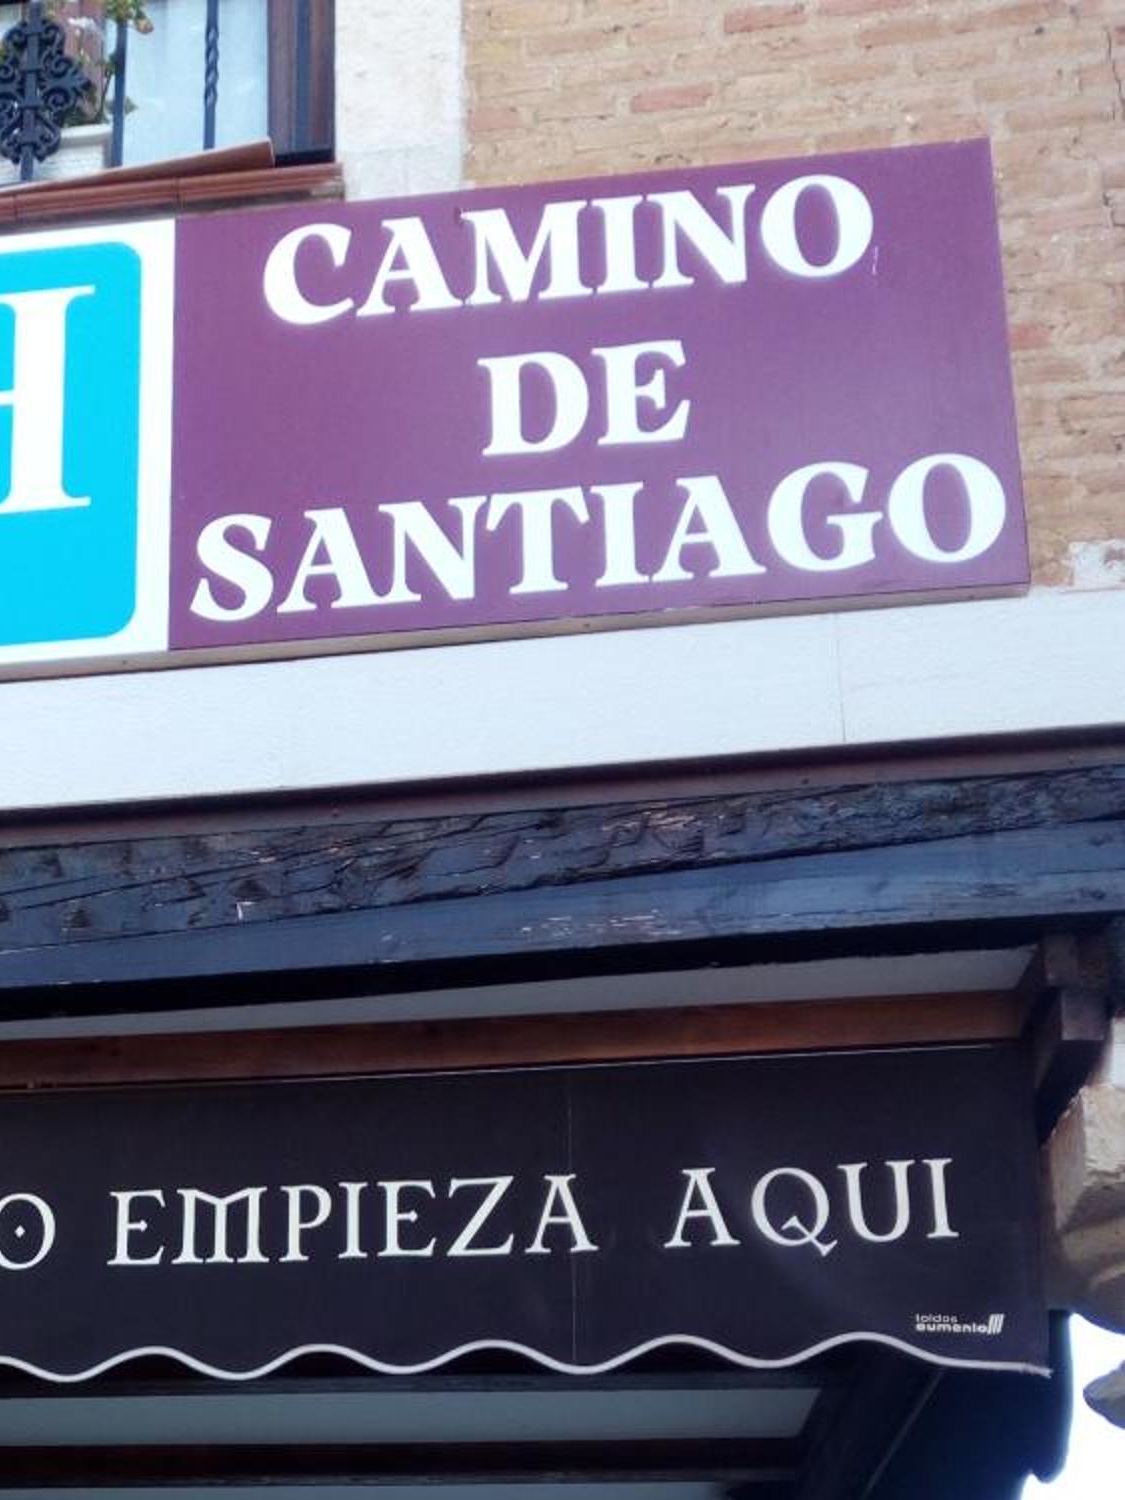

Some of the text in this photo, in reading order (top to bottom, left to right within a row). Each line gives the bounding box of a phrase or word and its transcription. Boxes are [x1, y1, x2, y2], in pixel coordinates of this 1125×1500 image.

[263, 174, 874, 326] CAMINO
[477, 339, 691, 457] DE
[190, 453, 1007, 623] SANTIAGO
[106, 1173, 599, 1267] EMPIEZA
[665, 1157, 960, 1258] AQUI
